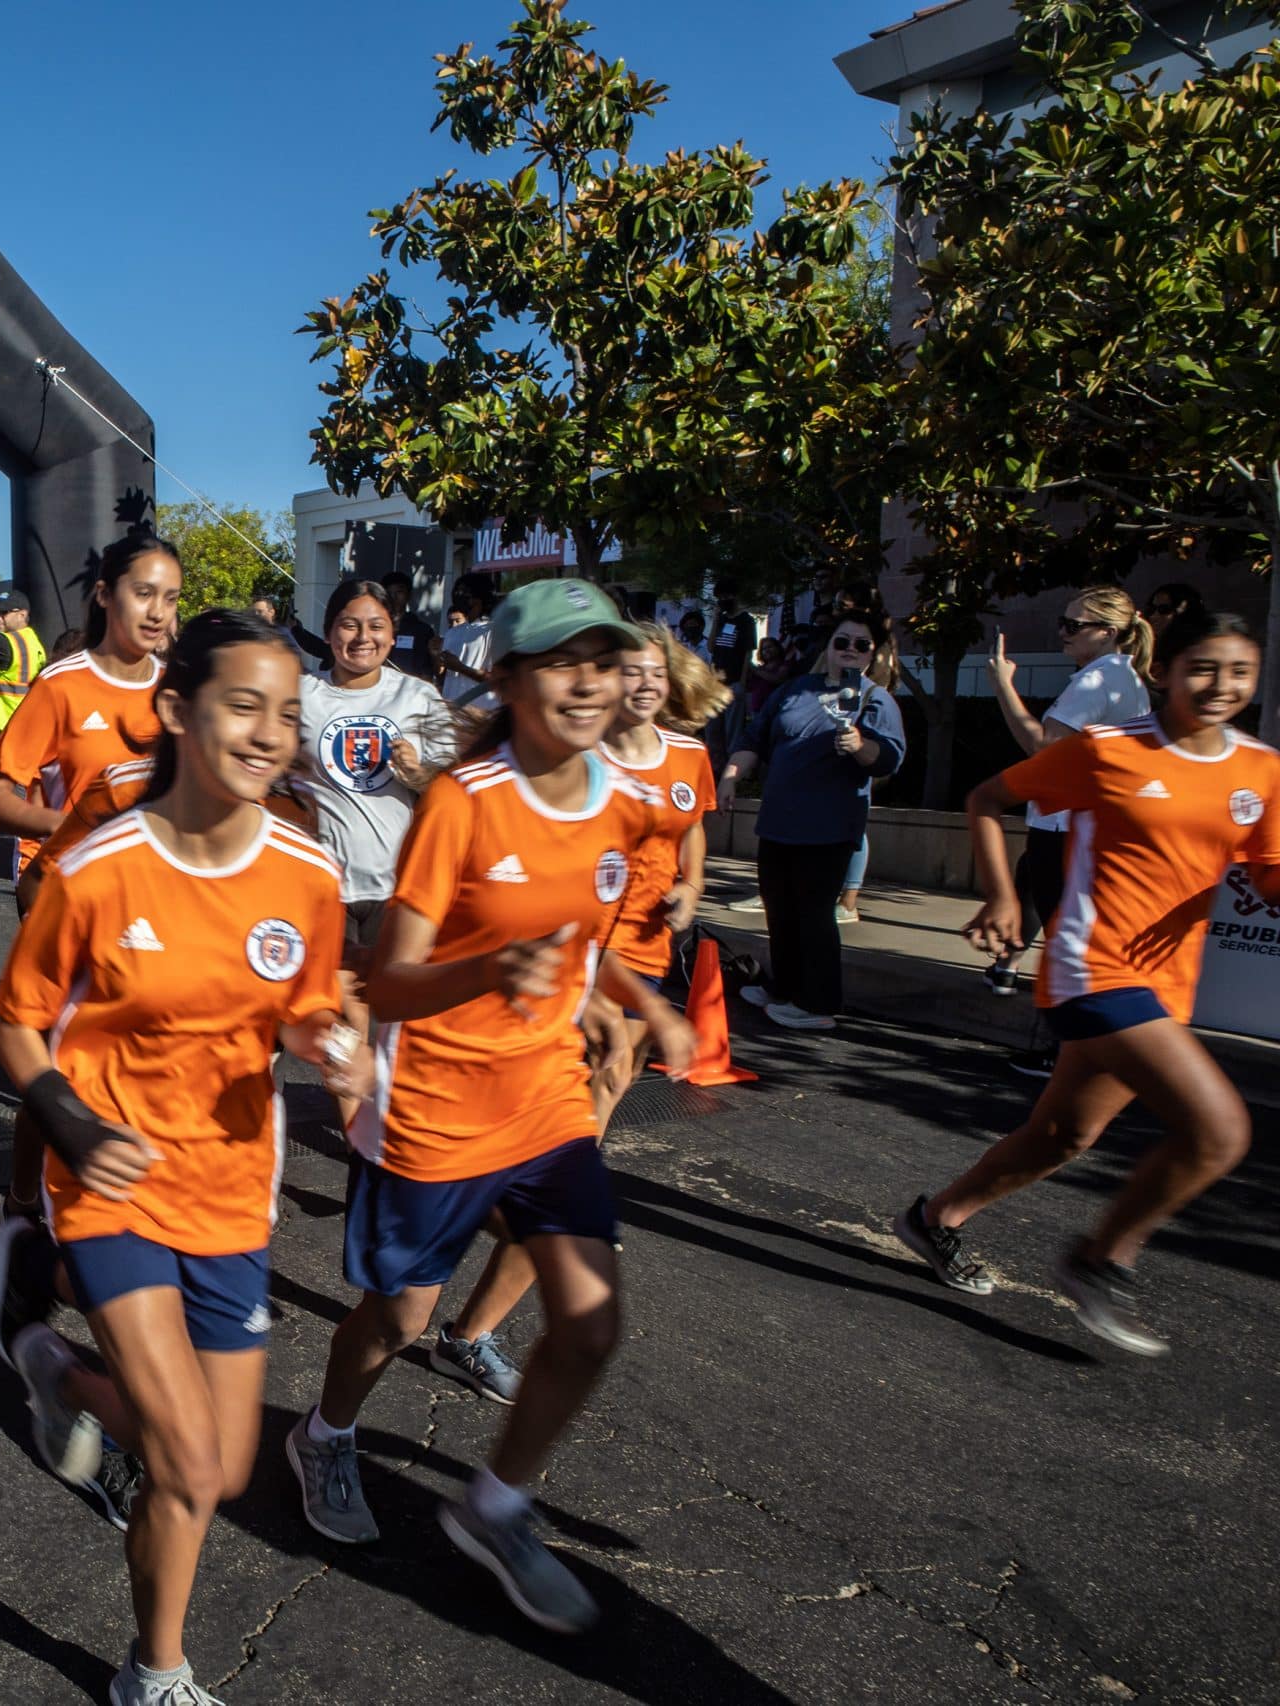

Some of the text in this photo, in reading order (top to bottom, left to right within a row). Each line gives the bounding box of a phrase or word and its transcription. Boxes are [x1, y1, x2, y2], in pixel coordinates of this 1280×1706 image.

[324, 717, 400, 741] RANGERS
[346, 729, 377, 738] RFC
[1210, 921, 1280, 945] EPUB
[1218, 939, 1280, 957] SERVICE
